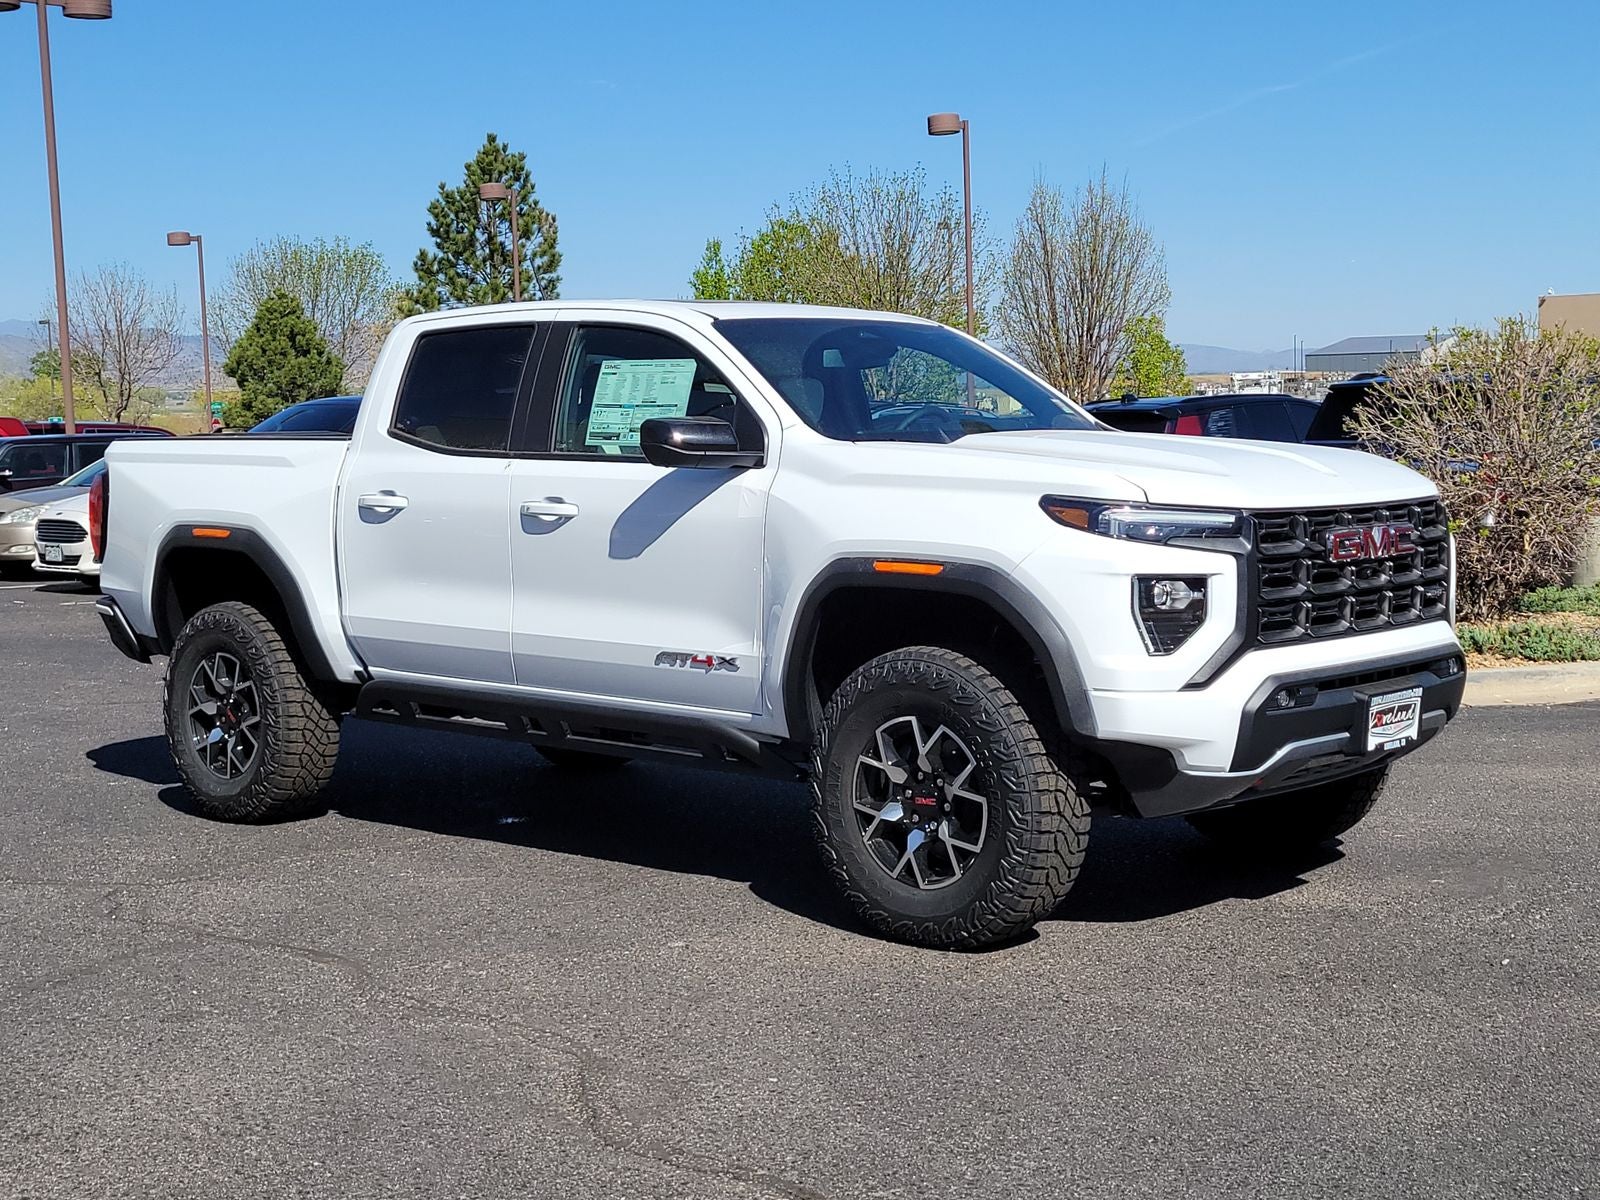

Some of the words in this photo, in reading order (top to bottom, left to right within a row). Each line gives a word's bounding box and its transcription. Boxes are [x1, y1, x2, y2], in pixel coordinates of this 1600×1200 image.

[1332, 526, 1416, 561] GMC
[654, 651, 740, 675] AT4X
[914, 796, 937, 806] GMC
